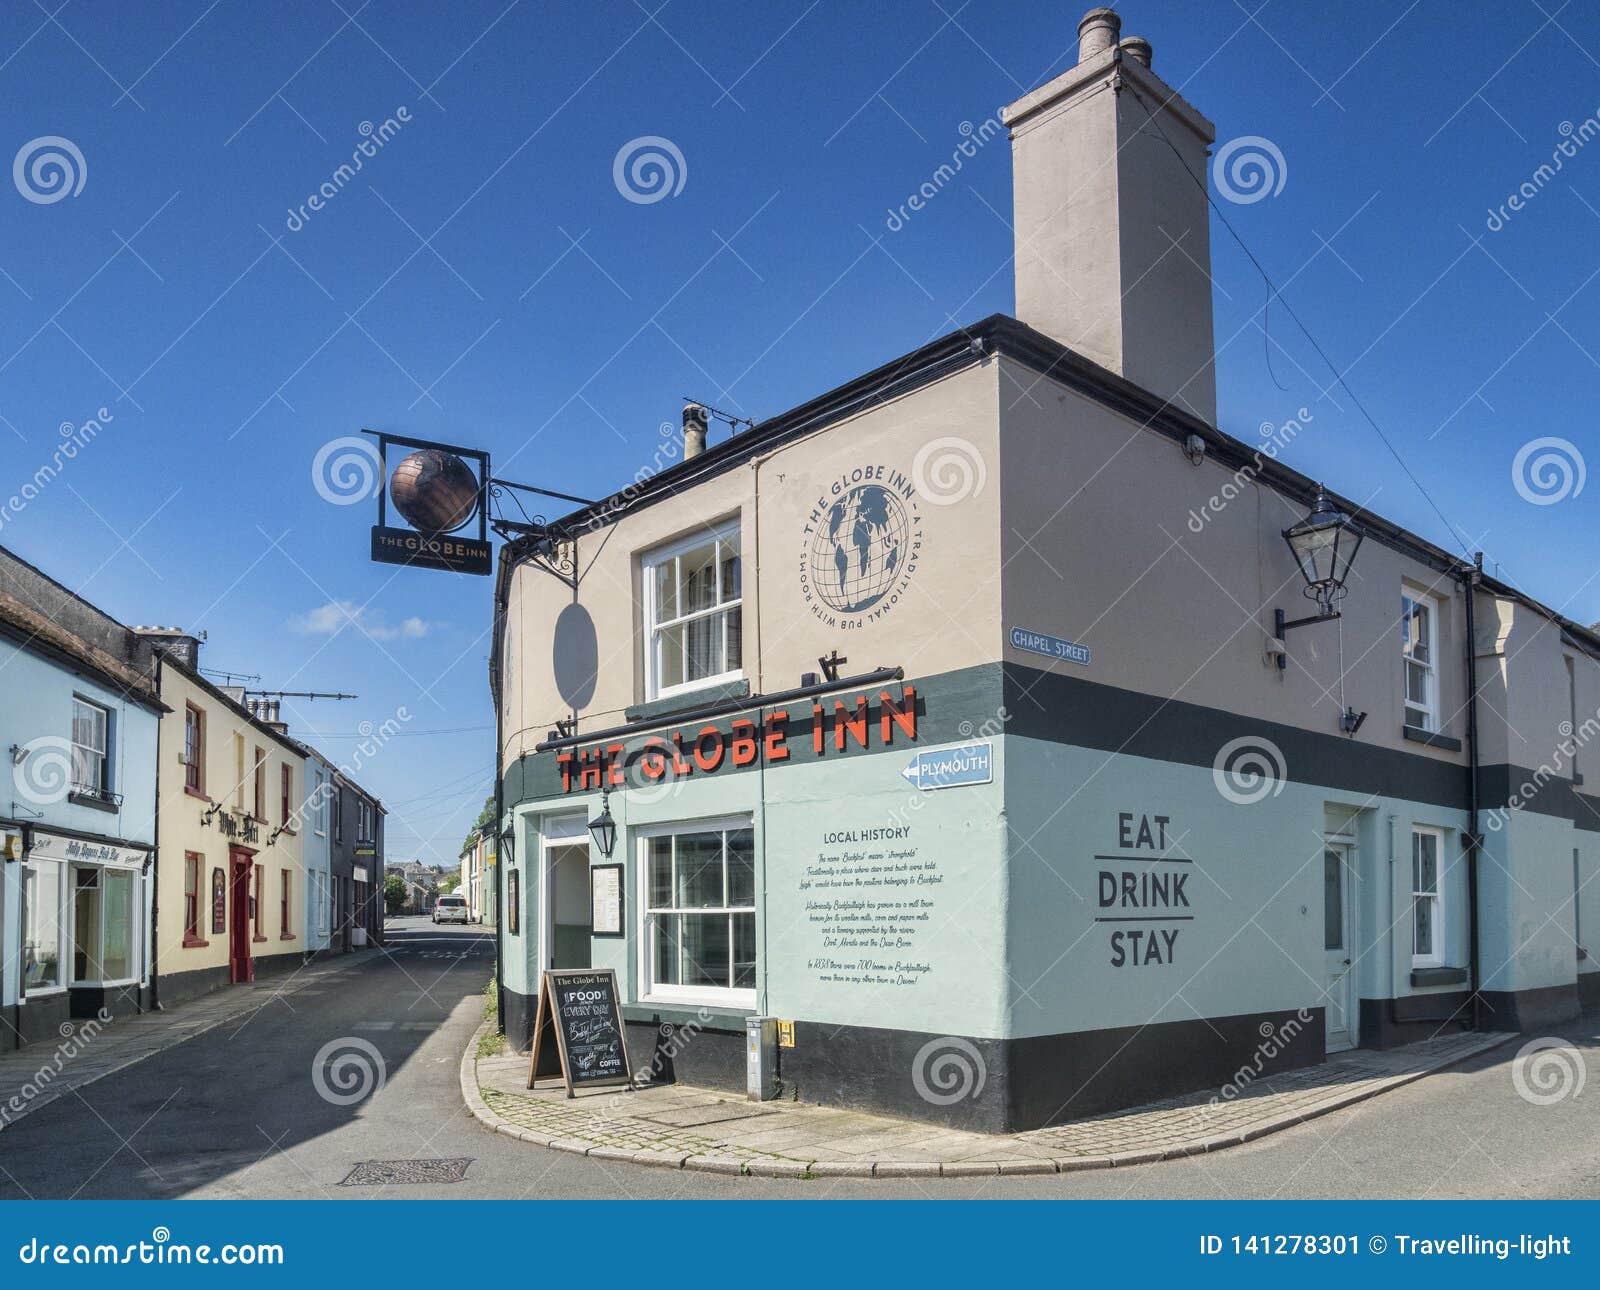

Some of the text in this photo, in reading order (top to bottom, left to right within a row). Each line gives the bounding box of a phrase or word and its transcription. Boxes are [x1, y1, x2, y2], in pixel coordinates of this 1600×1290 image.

[804, 465, 915, 534] THE GLOBE INN
[380, 536, 403, 547] THE
[405, 537, 465, 556] GLOBE
[466, 549, 488, 558] INN
[800, 516, 922, 630] A TRADITIONAL PUB WITH ROOMS
[1013, 631, 1088, 661] CHAPEL STREET
[556, 685, 915, 793] THE GLOBE INN
[921, 756, 988, 777] PLYMOUTH
[824, 826, 911, 844] LOCAL HISTORY
[1119, 812, 1170, 850] EAT
[1098, 871, 1190, 907] DRINK
[1110, 929, 1179, 967] STAY
[557, 975, 609, 985] The Globe Inn
[569, 991, 602, 1002] FOOD
[564, 1005, 591, 1017] EVERY
[600, 1059, 620, 1068] COFFEE
